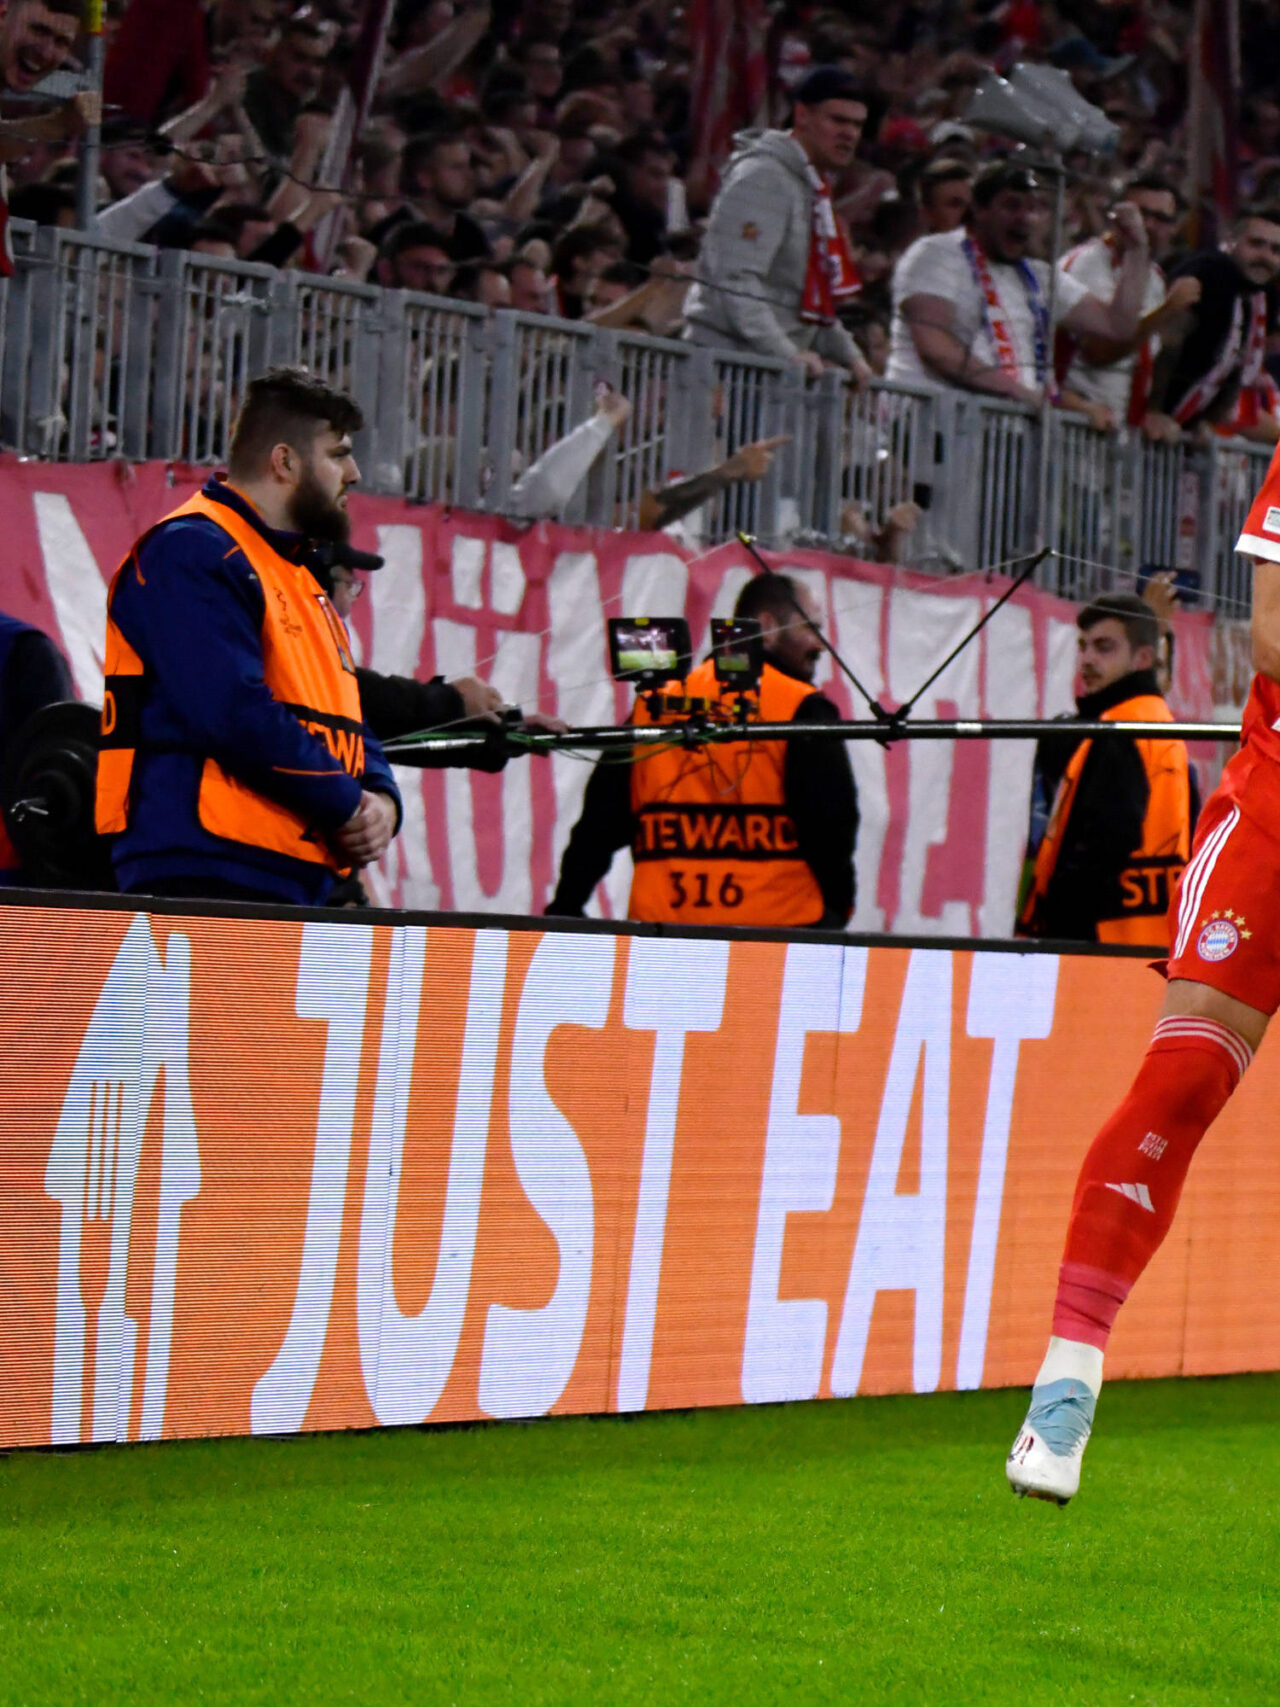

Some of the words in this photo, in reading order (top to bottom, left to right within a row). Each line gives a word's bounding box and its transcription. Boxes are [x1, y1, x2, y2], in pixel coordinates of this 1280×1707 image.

[634, 812, 799, 851] TEWARD
[668, 871, 744, 909] 316
[249, 921, 730, 1436] JUST
[740, 942, 1059, 1404] EAT
